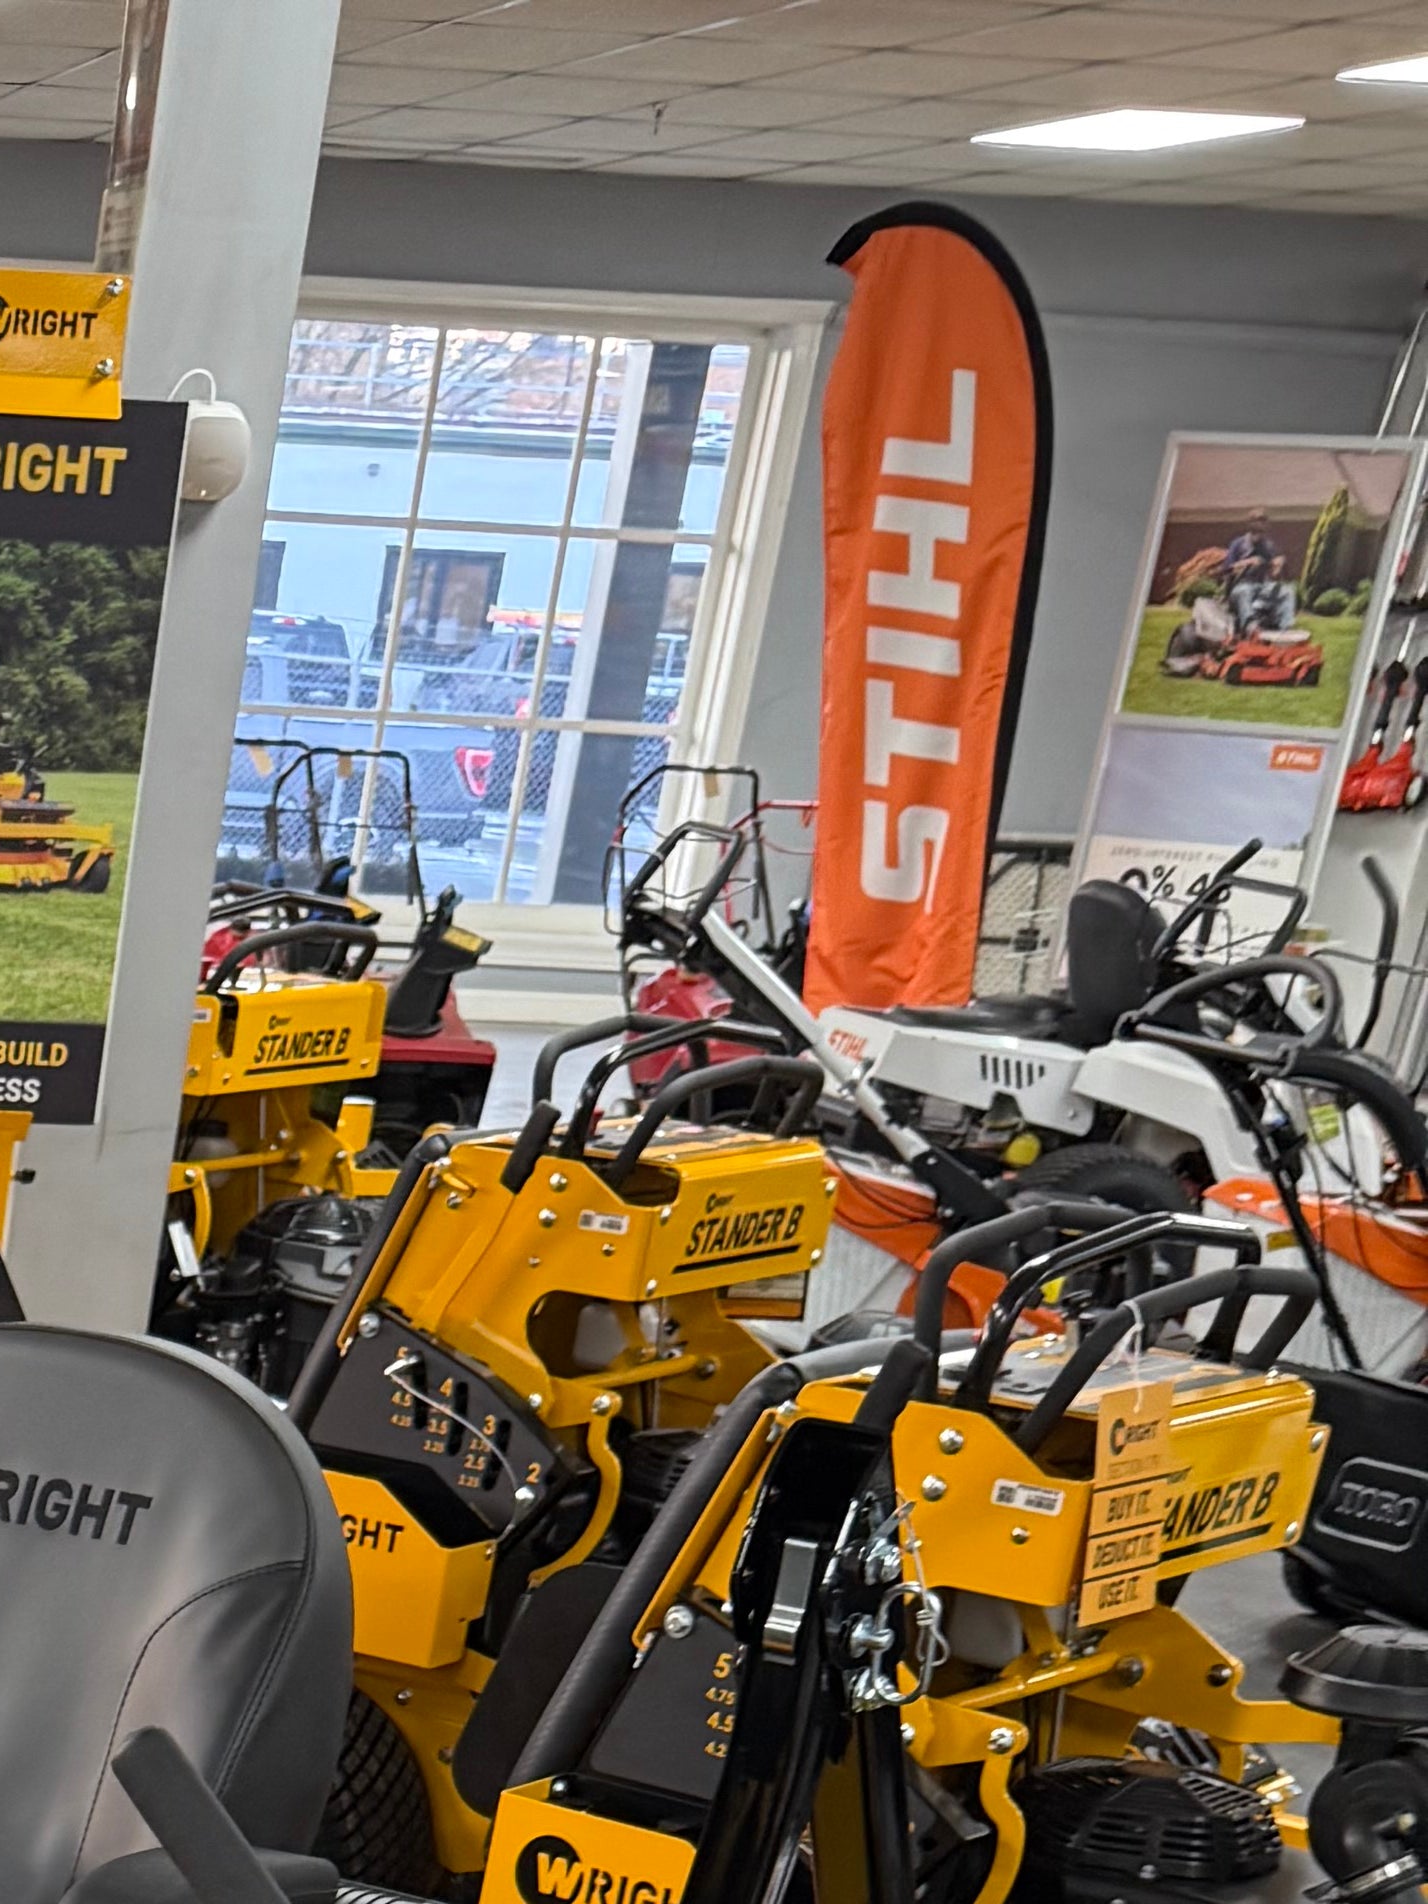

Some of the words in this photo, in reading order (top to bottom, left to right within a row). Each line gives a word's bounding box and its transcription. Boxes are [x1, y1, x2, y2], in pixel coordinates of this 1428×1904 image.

[860, 369, 977, 916] STIHL
[254, 1028, 336, 1064] STANDER
[335, 1027, 351, 1056] B
[685, 1207, 788, 1257] STANDER
[784, 1204, 805, 1240] B
[439, 1377, 454, 1398] 4
[482, 1414, 497, 1436] 3
[525, 1462, 542, 1484] 2
[1106, 1492, 1135, 1523] BUY
[1161, 1476, 1258, 1542] ANDER
[1251, 1471, 1281, 1520] B
[340, 1513, 405, 1553] GHT
[712, 1652, 734, 1679] 5
[706, 1711, 736, 1734] 4.5
[704, 1740, 728, 1758] 4.2
